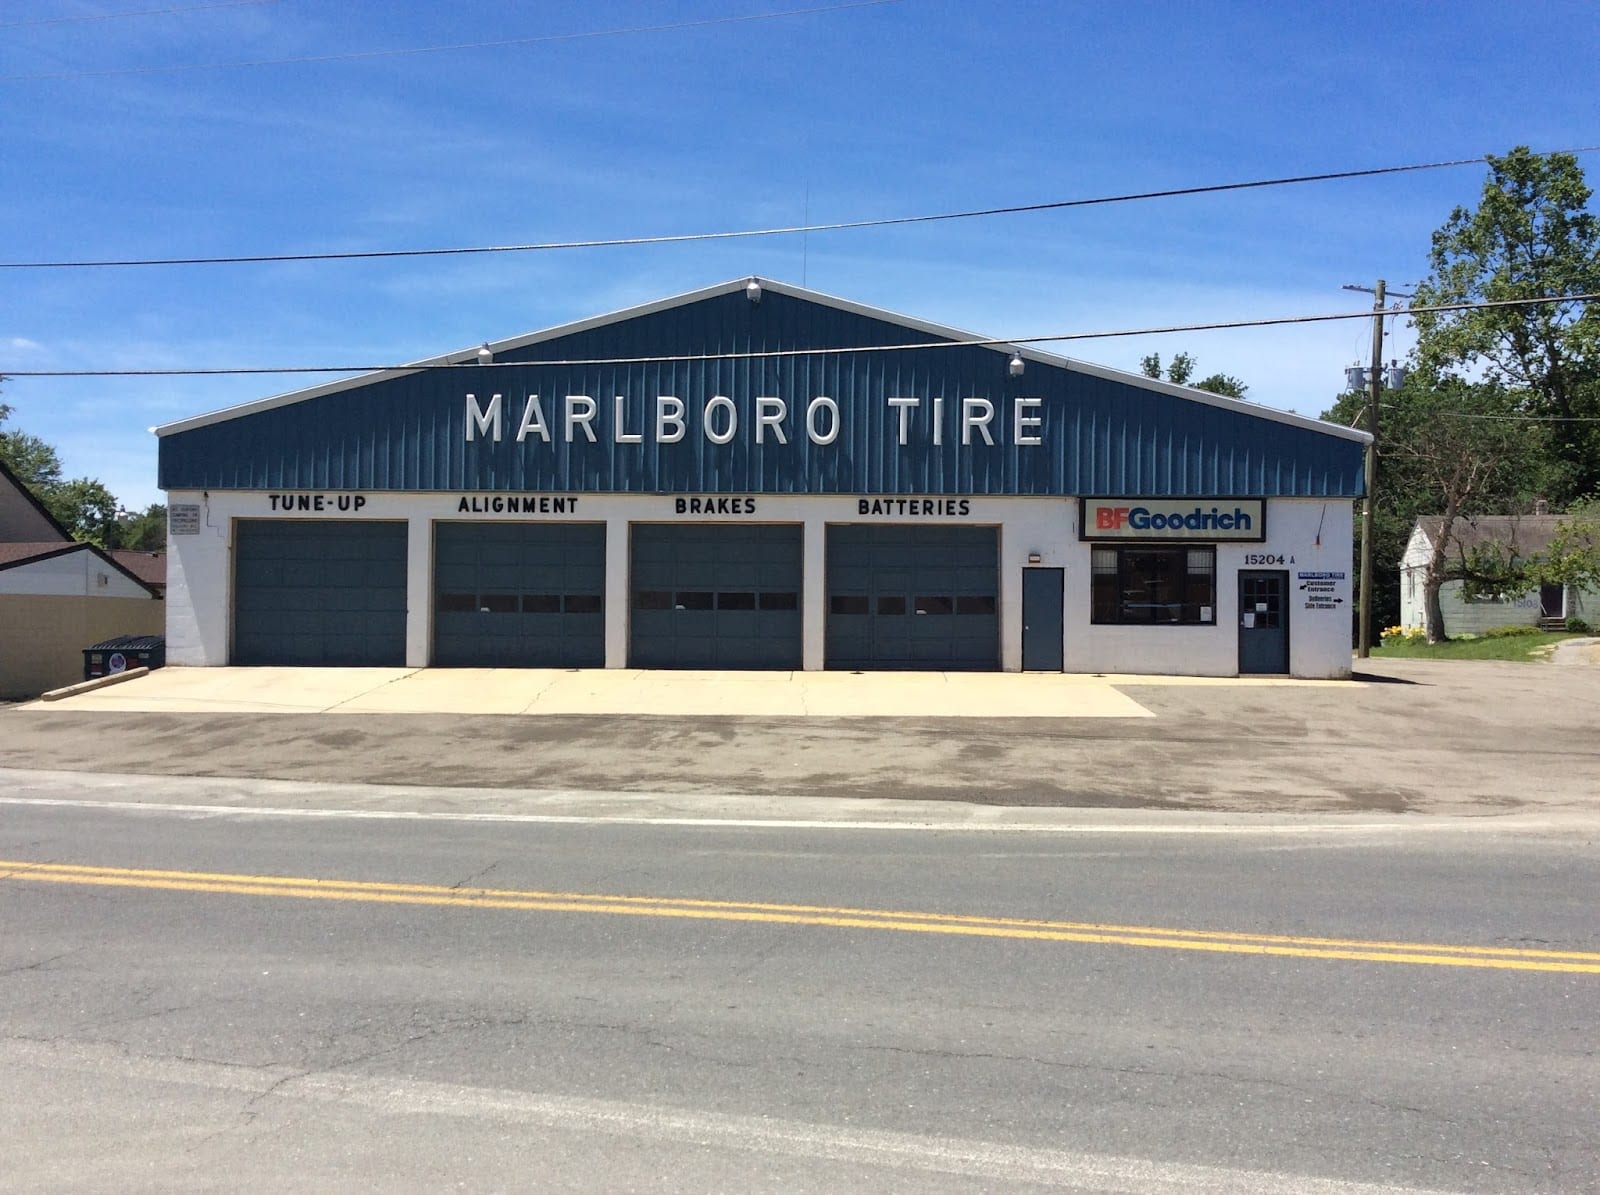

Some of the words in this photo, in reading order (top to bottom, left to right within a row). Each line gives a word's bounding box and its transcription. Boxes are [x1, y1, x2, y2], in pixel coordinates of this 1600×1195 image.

[465, 394, 841, 446] MARLBORO
[887, 396, 1042, 447] TIRE
[269, 494, 366, 513] TUNE-UP
[458, 496, 578, 514] ALIGNMENT
[675, 497, 756, 515] BRAKES
[858, 498, 970, 516] BATTERIES
[1096, 507, 1251, 530] BFGoodrich
[1244, 554, 1285, 565] 15204
[1289, 556, 1296, 565] A
